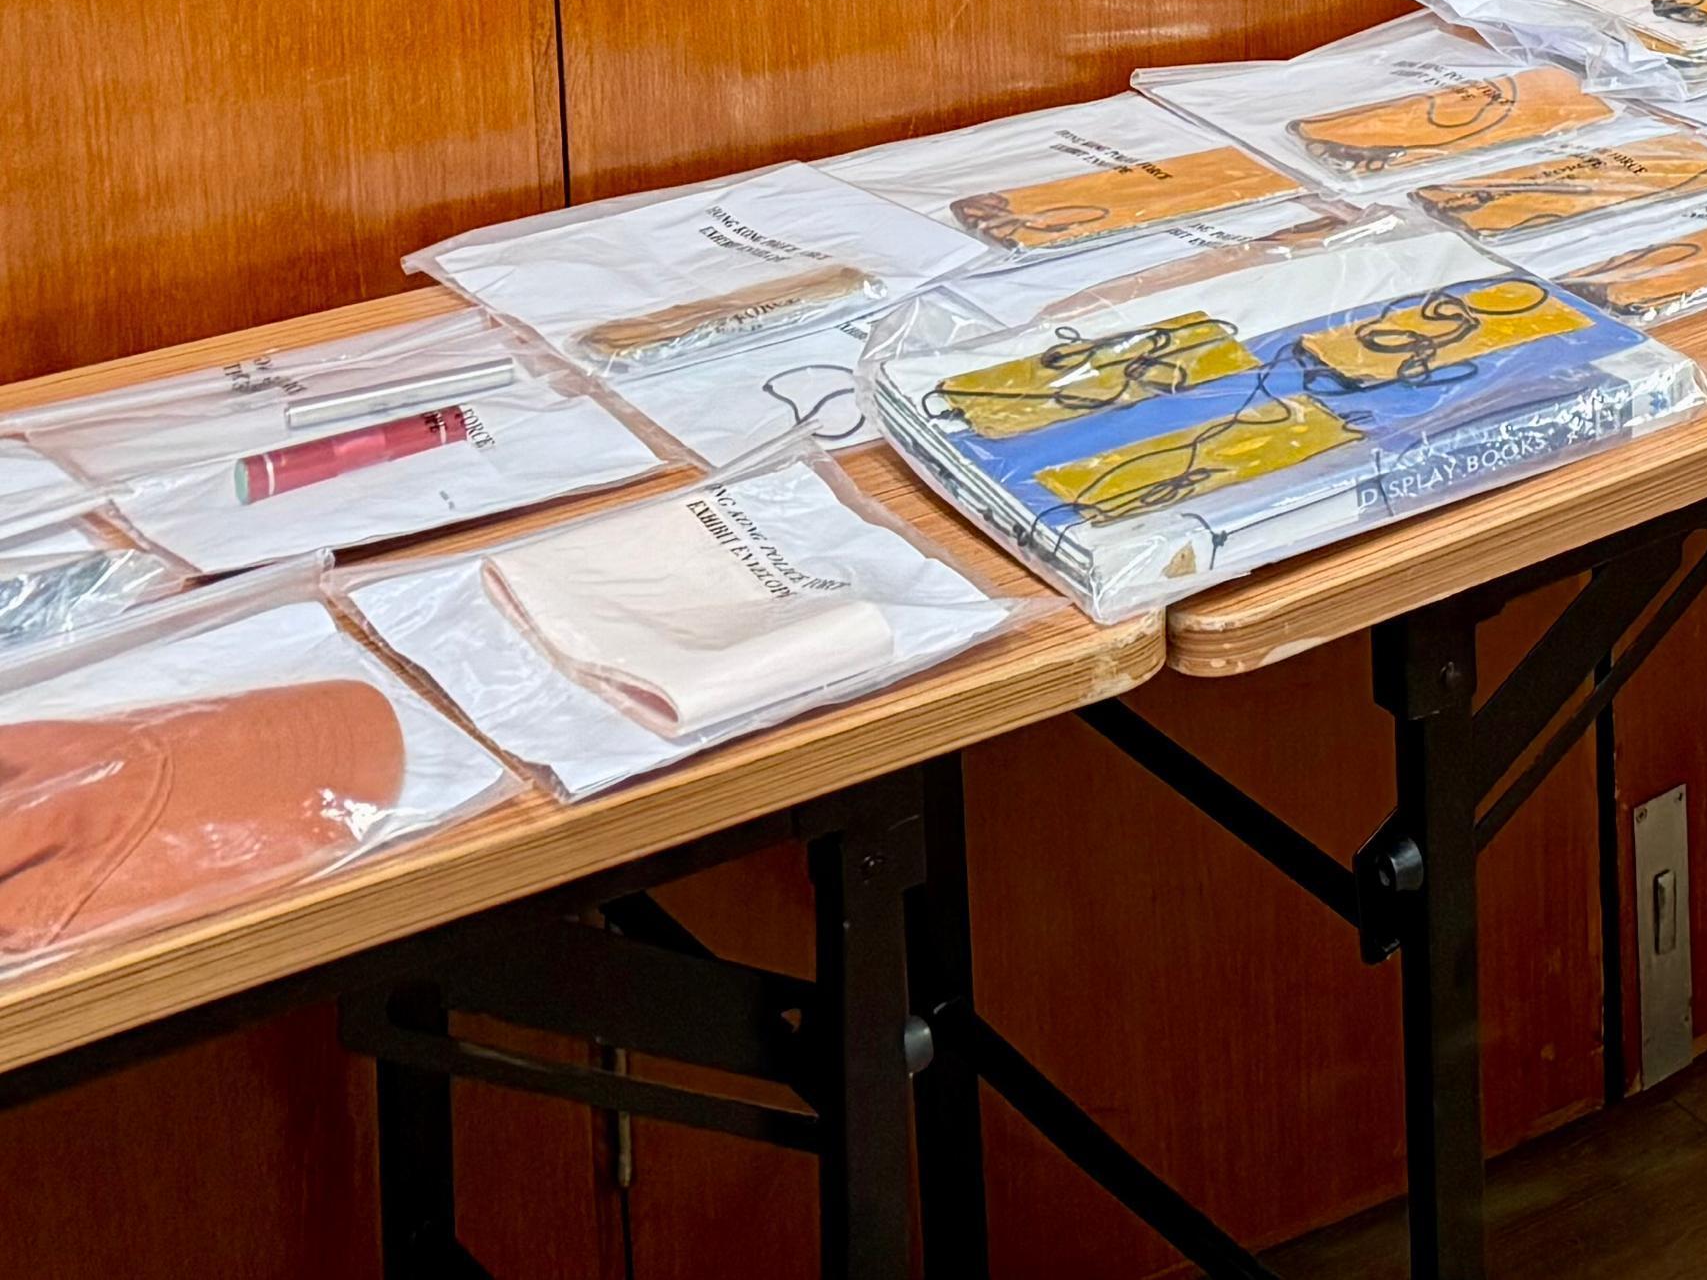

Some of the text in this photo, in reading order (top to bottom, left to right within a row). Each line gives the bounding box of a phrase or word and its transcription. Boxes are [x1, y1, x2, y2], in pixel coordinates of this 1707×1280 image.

[1465, 437, 1548, 473] BOOKS
[685, 499, 742, 546] EXHIBIT
[759, 544, 811, 584] POLICE
